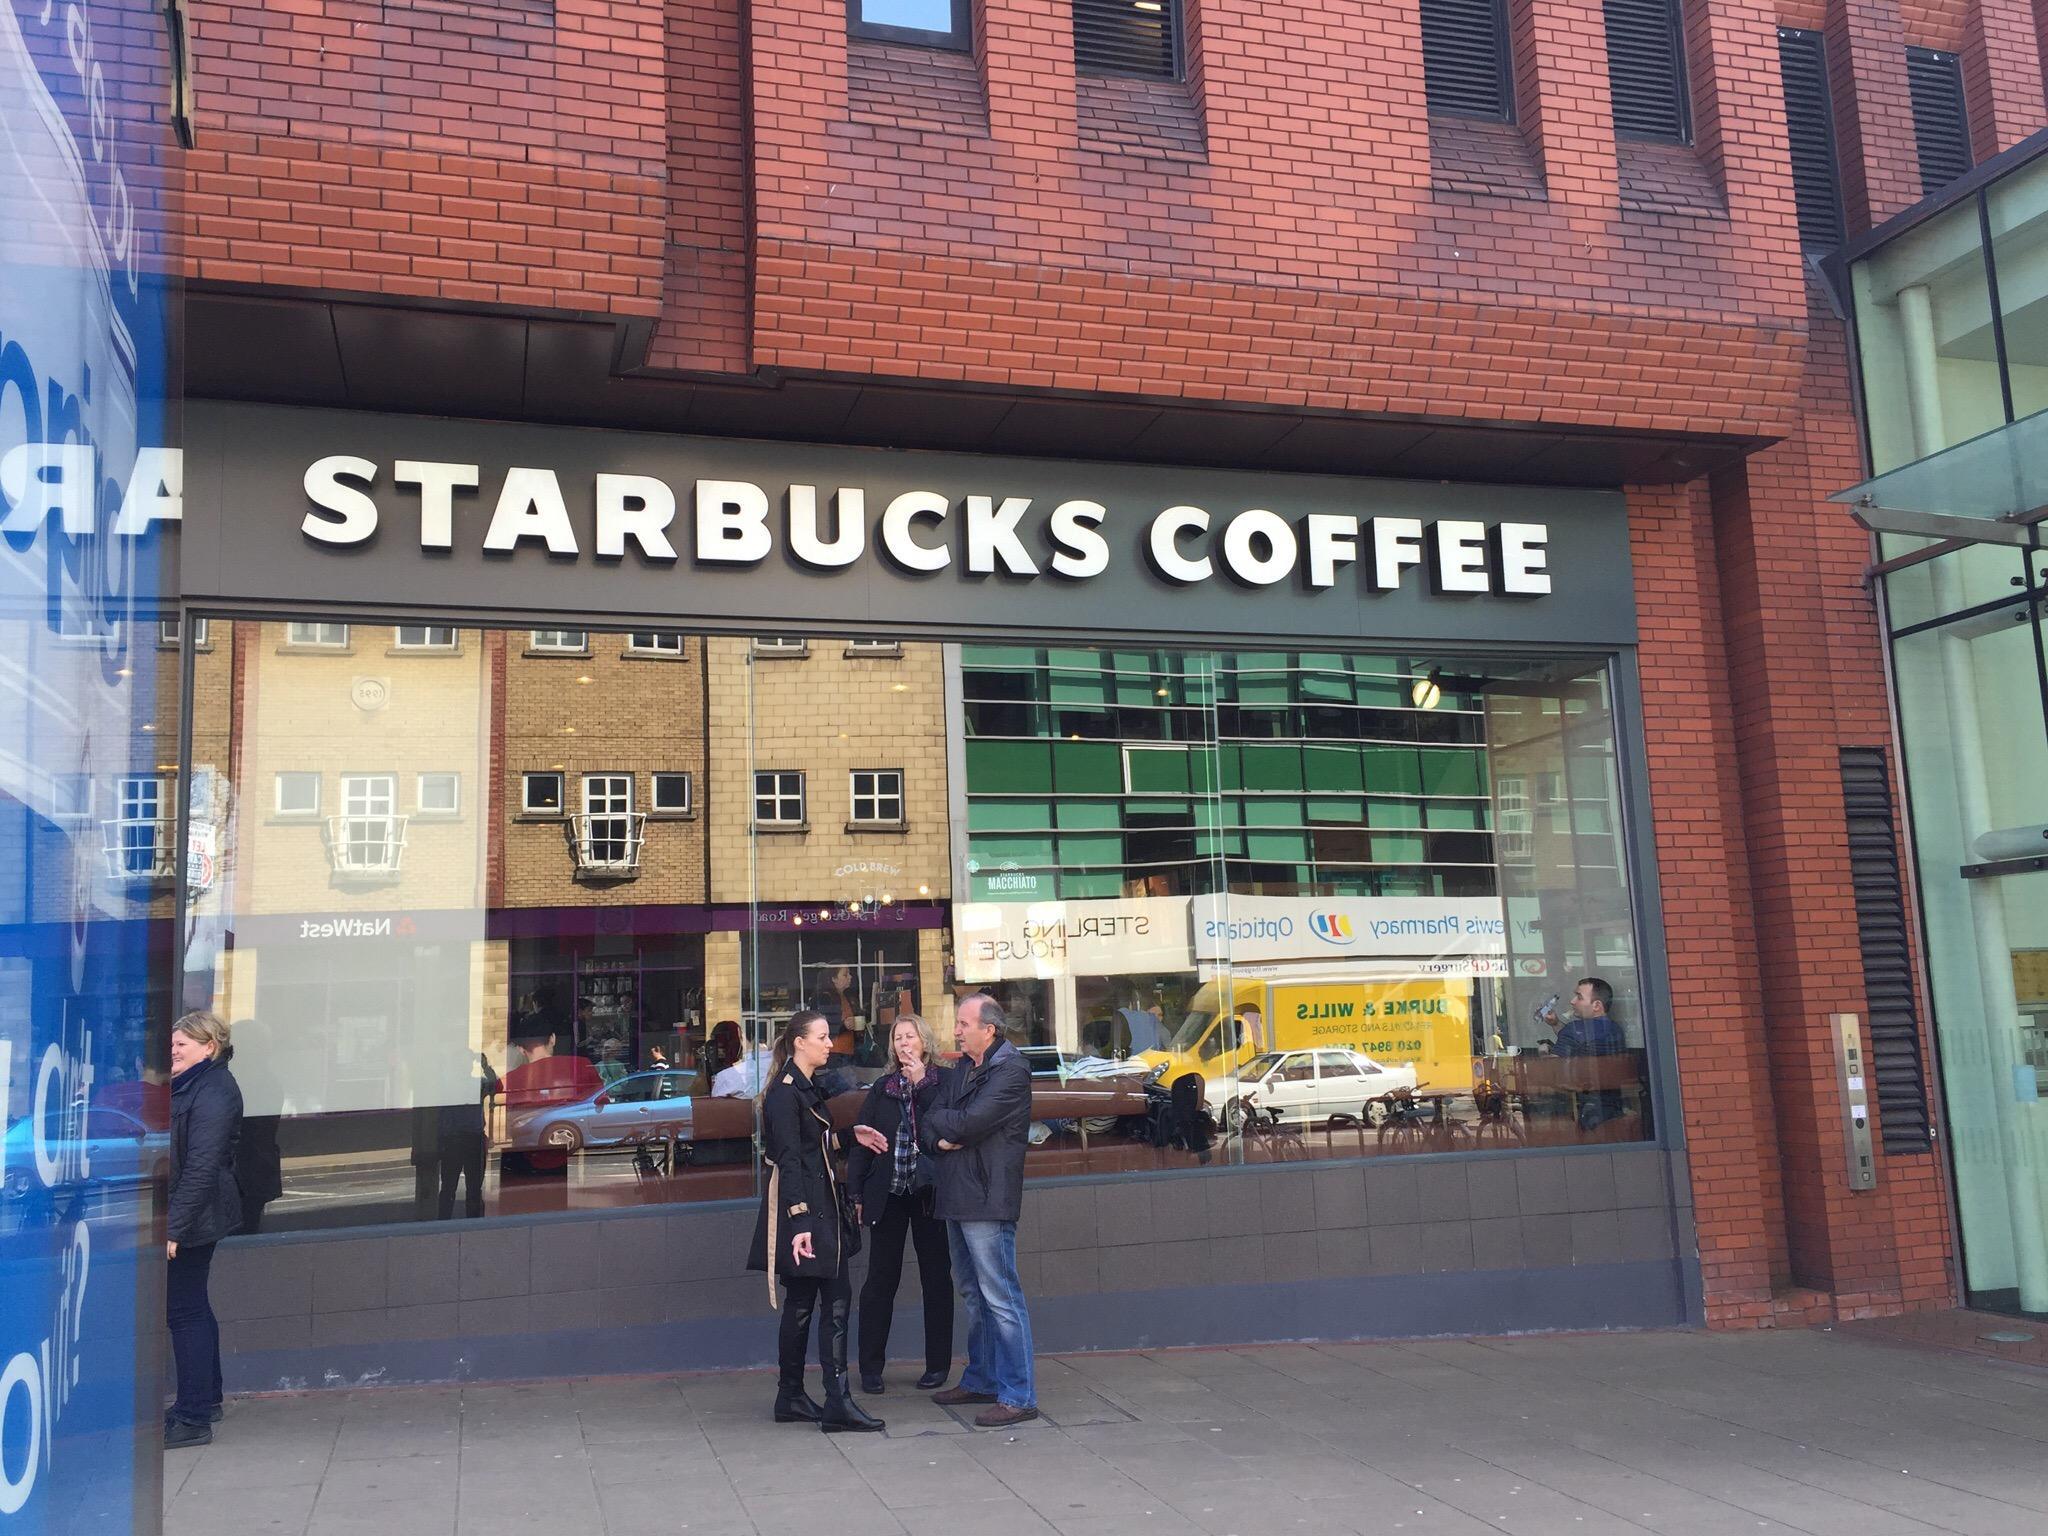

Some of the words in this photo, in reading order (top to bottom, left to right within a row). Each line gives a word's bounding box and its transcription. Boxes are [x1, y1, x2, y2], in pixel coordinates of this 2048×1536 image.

[301, 455, 1111, 580] STARBUCKS
[1147, 505, 1552, 596] COFFEE
[833, 862, 869, 877] COLD
[988, 876, 1037, 890] MACCHIATO
